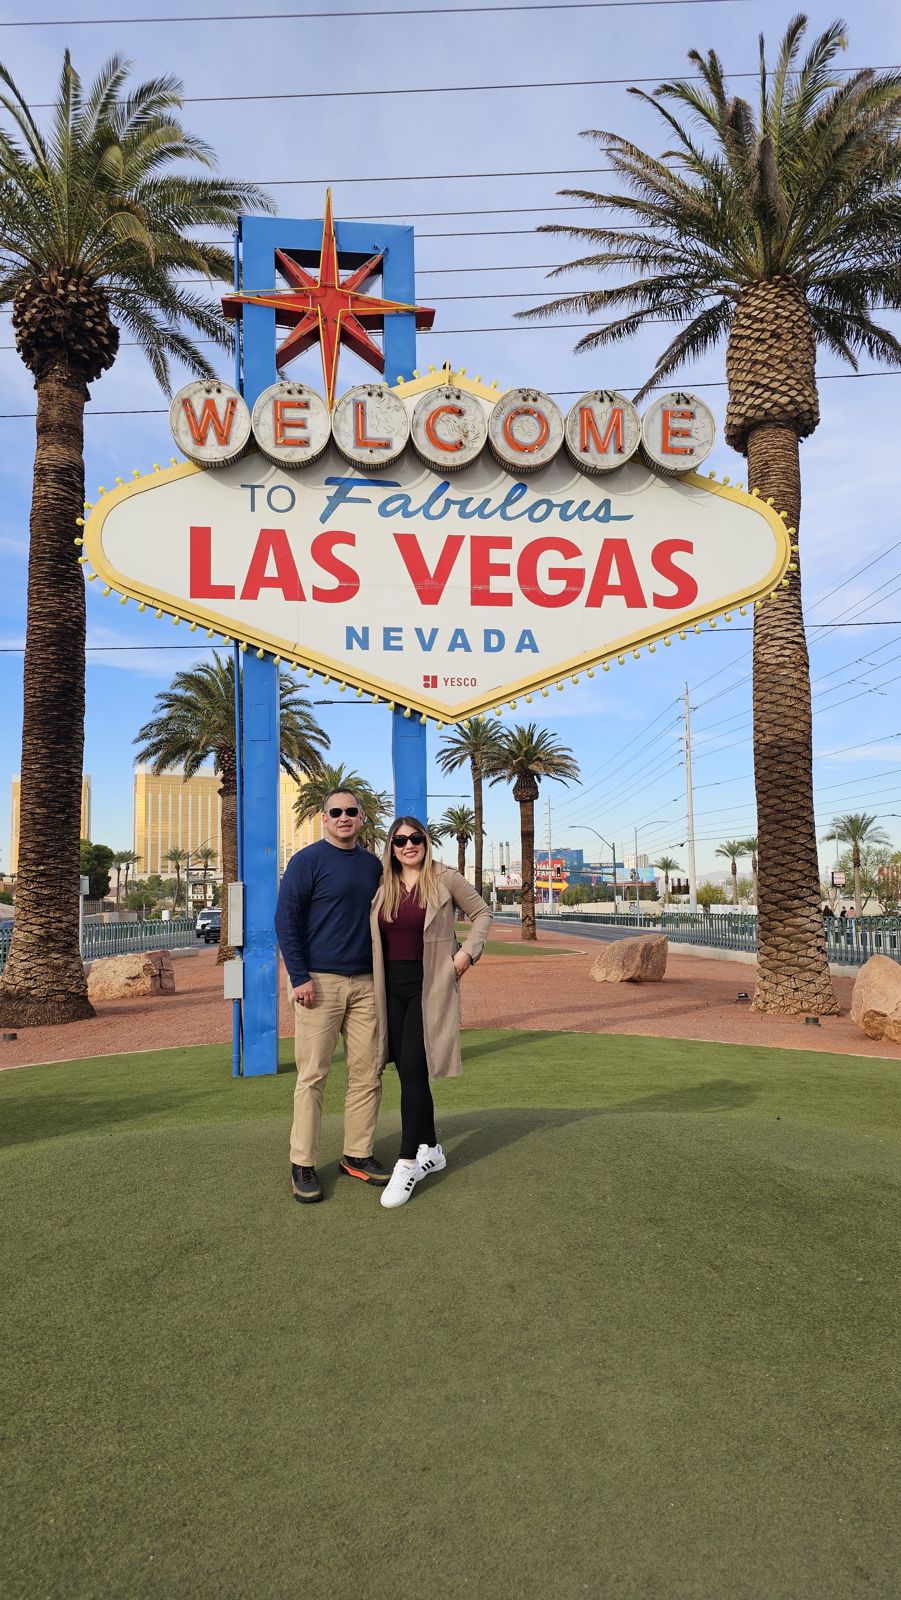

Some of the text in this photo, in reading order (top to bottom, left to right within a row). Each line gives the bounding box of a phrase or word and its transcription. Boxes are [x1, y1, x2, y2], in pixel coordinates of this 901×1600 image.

[181, 397, 695, 456] WELCOME
[240, 476, 634, 525] TO Fabulous
[189, 526, 699, 610] LAS VEGAS
[345, 625, 541, 655] NEVADA
[442, 677, 478, 687] YESCO
